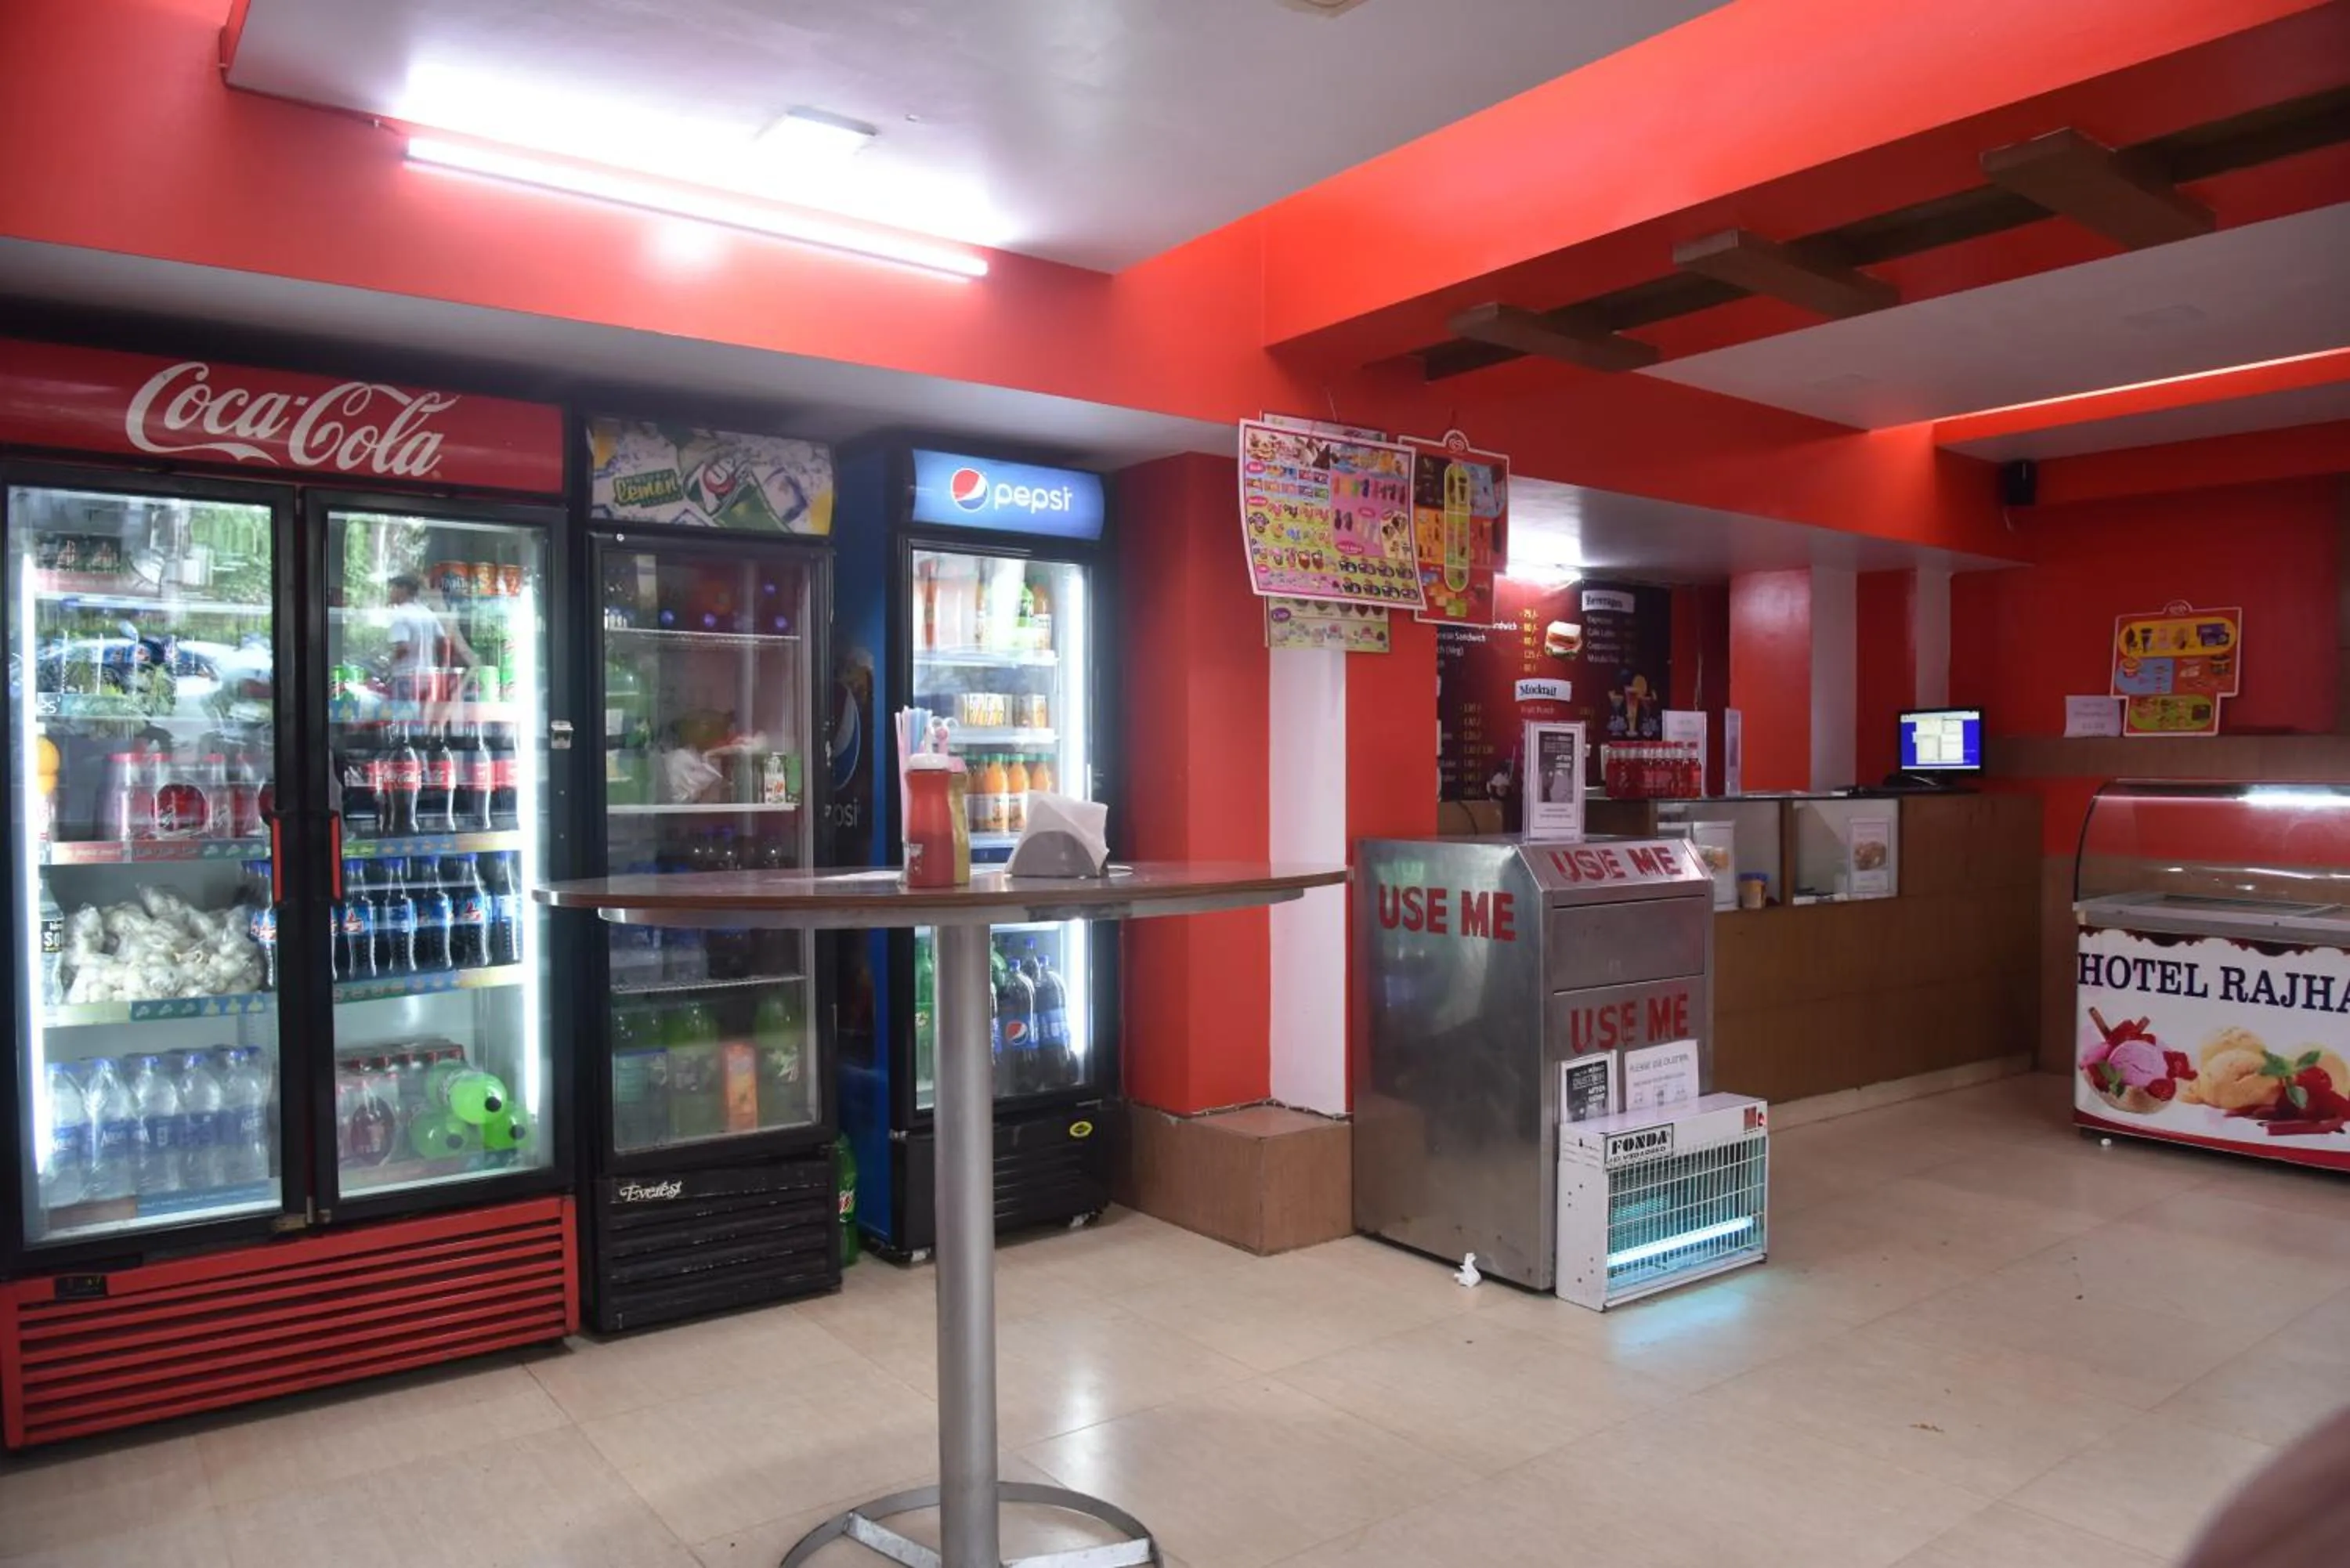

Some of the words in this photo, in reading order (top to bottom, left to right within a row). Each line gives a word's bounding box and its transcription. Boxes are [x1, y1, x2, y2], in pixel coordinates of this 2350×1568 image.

[126, 361, 461, 477] Coca-Cola
[994, 482, 1072, 515] pepsi
[1549, 849, 1626, 883] USE
[1626, 847, 1683, 876] ME
[1379, 883, 1448, 934] USE
[1460, 889, 1517, 942] ME
[2077, 952, 2209, 999] HOTEL
[1571, 1000, 1637, 1054] USE
[1647, 992, 1688, 1042] ME
[1611, 1130, 1668, 1155] FONDA
